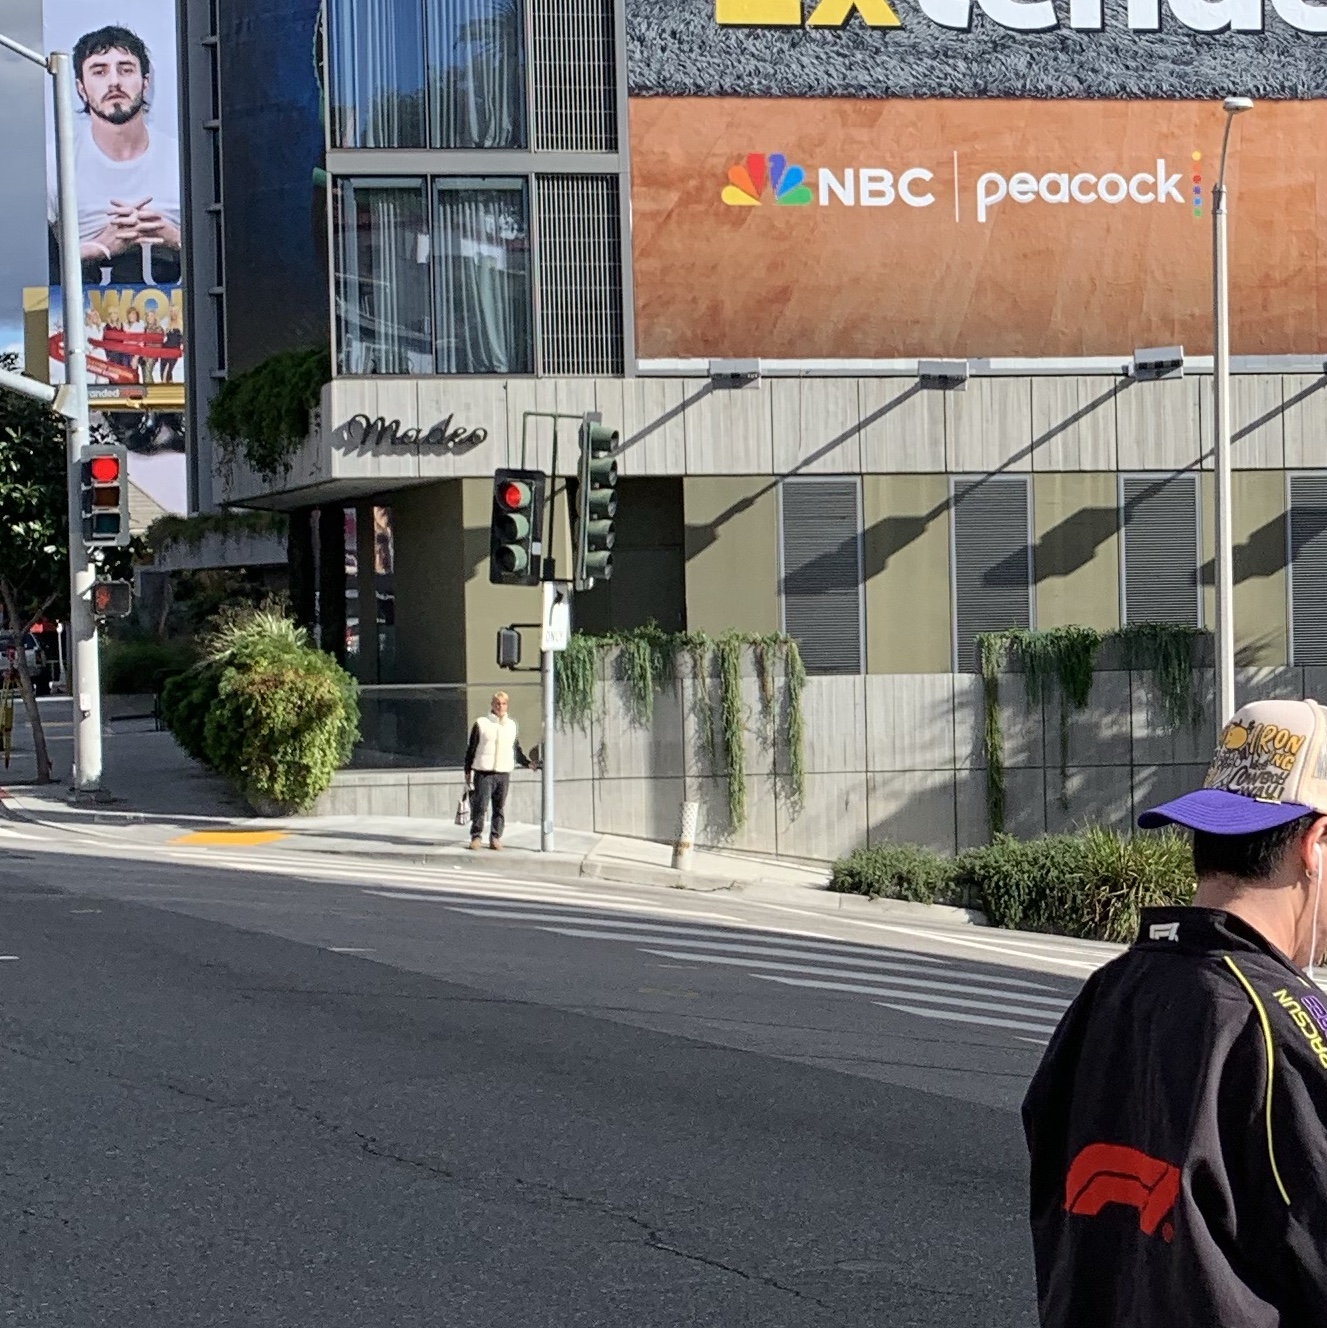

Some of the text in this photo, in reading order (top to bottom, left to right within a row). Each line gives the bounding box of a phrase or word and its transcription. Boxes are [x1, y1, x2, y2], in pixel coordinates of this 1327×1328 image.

[819, 168, 935, 206] NBC
[977, 159, 1184, 222] peacock
[348, 413, 488, 446] Madeo
